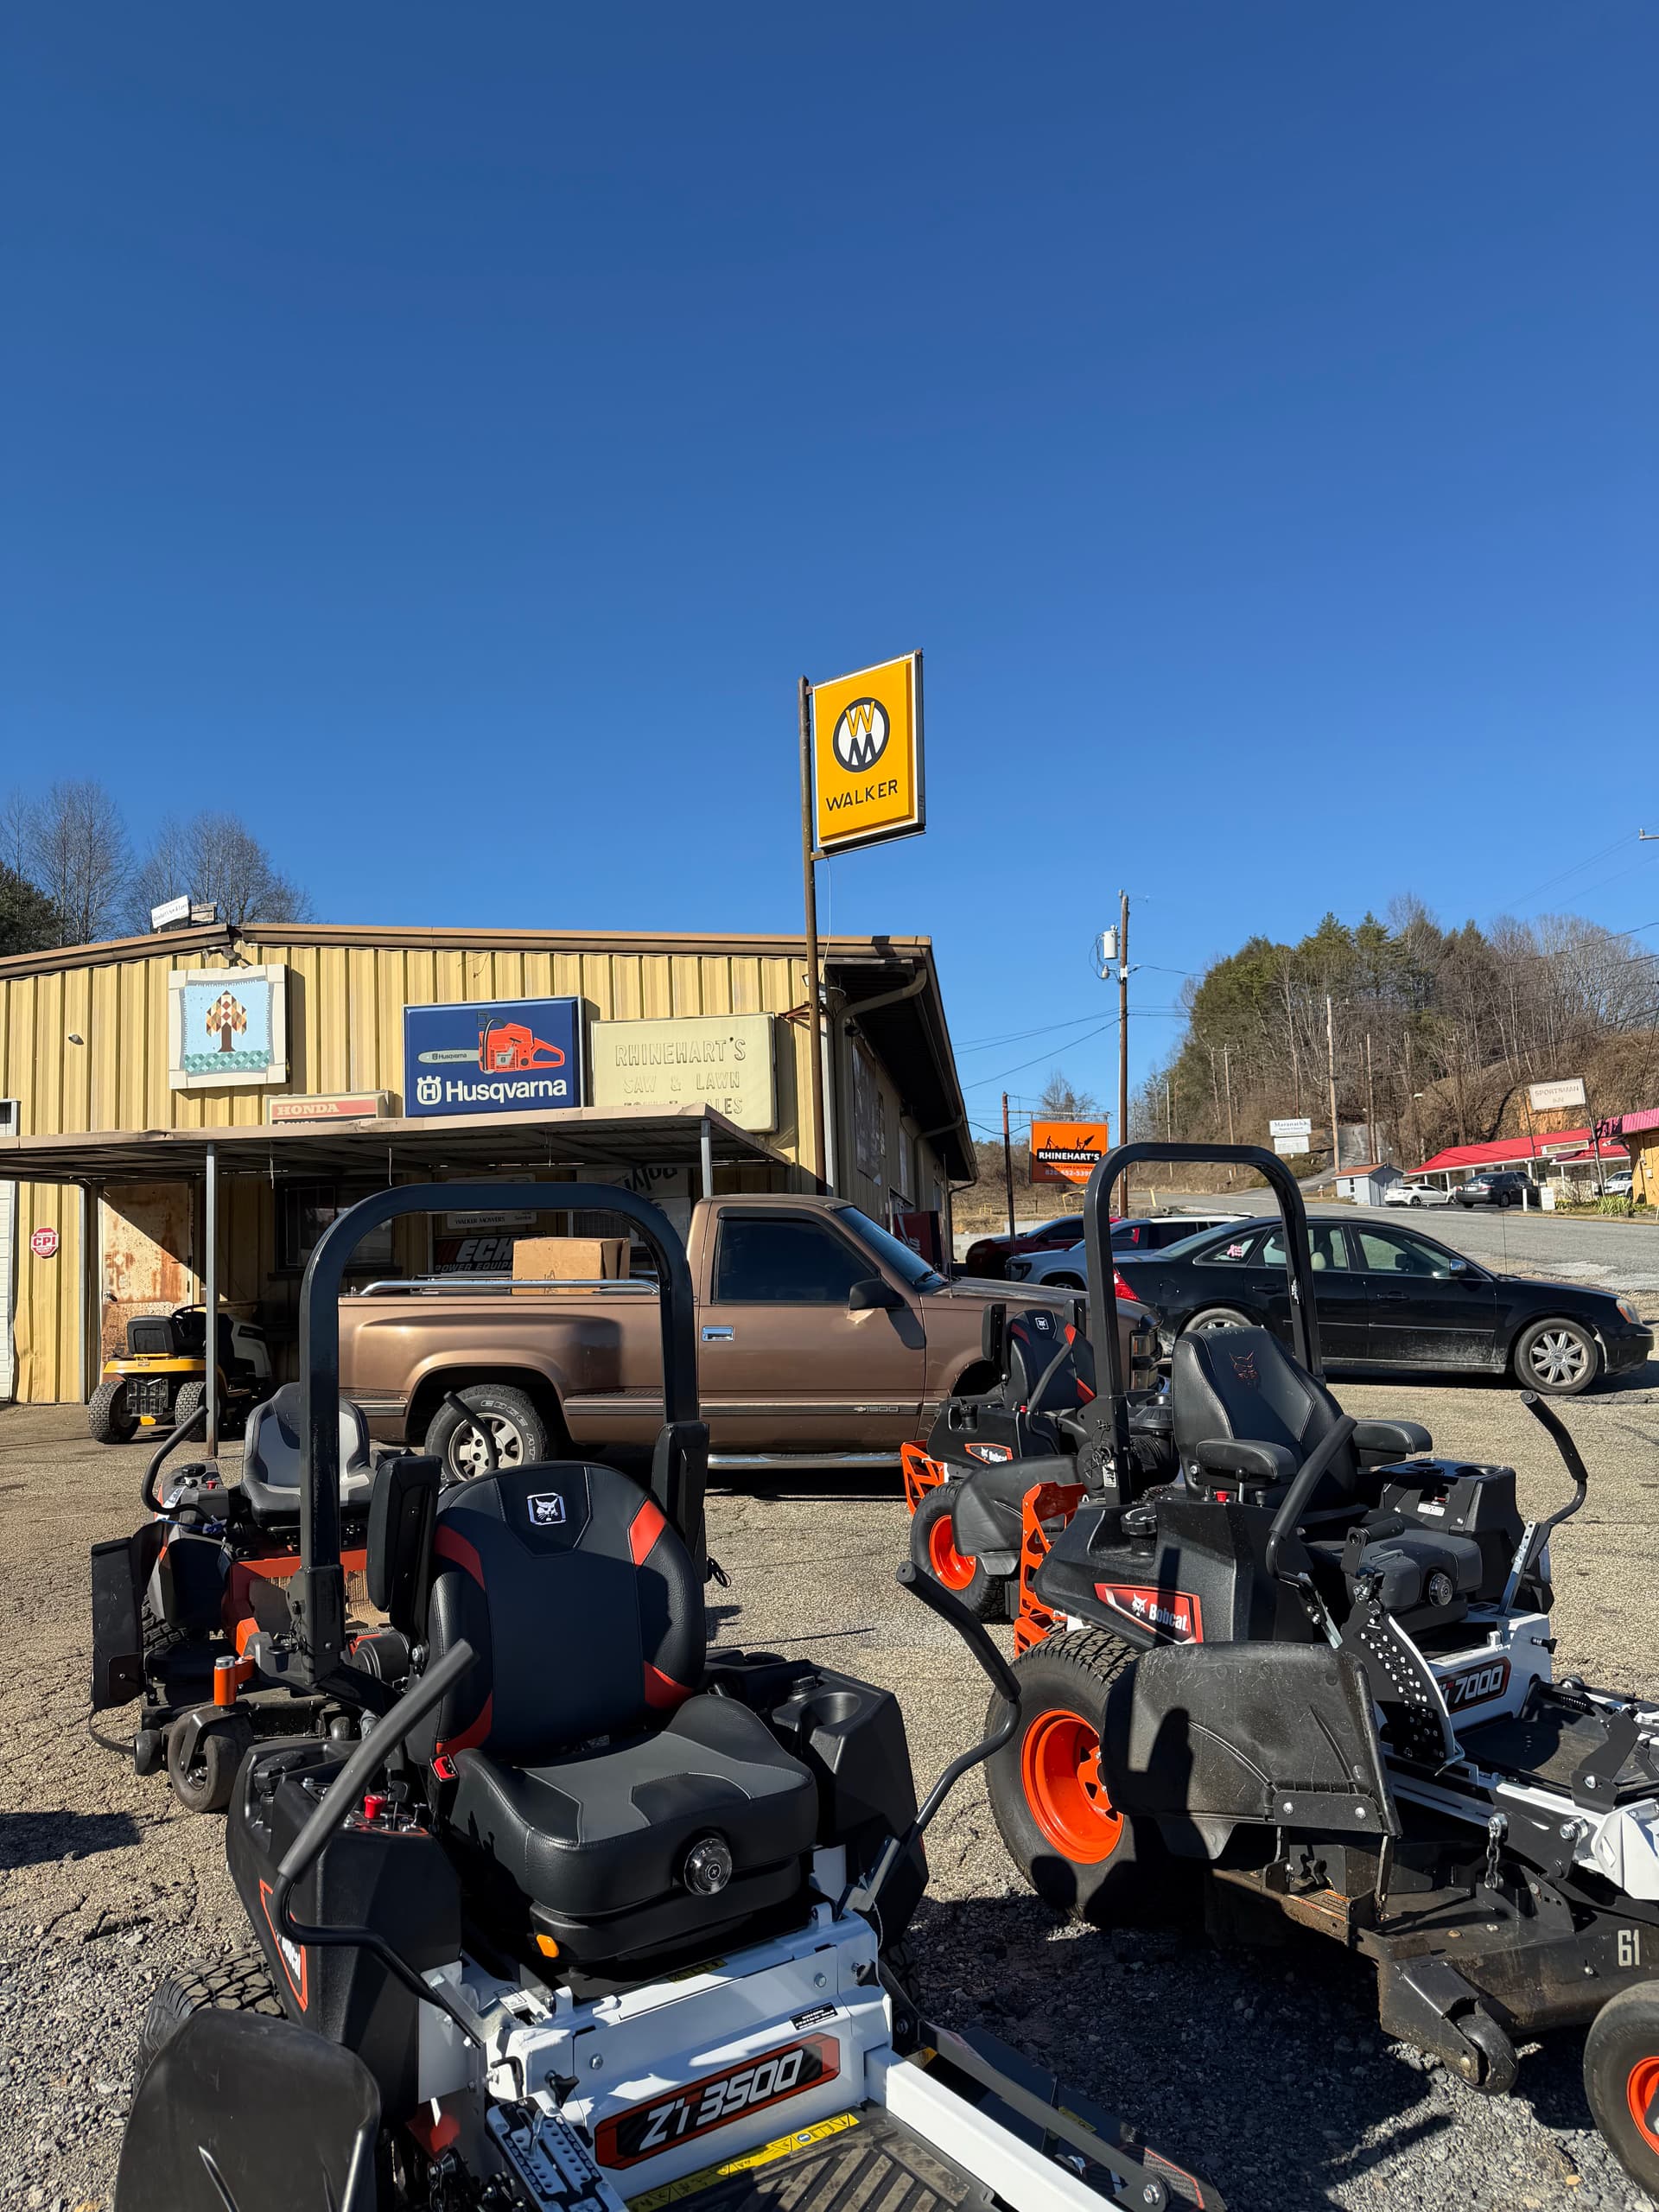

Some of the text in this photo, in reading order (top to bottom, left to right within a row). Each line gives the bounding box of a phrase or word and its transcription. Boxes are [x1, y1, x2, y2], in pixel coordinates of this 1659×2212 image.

[826, 779, 898, 811] WALKER
[615, 1037, 746, 1066] RHINEHART'S
[446, 1079, 567, 1103] Husqvarna
[624, 1071, 740, 1094] SAW & LAWN
[276, 1103, 339, 1116] HONDA
[1039, 1151, 1100, 1160] RHINEHART'S
[33, 1236, 56, 1246] CPI
[1148, 1604, 1188, 1632] Bobcat
[1618, 1929, 1640, 1967] 61
